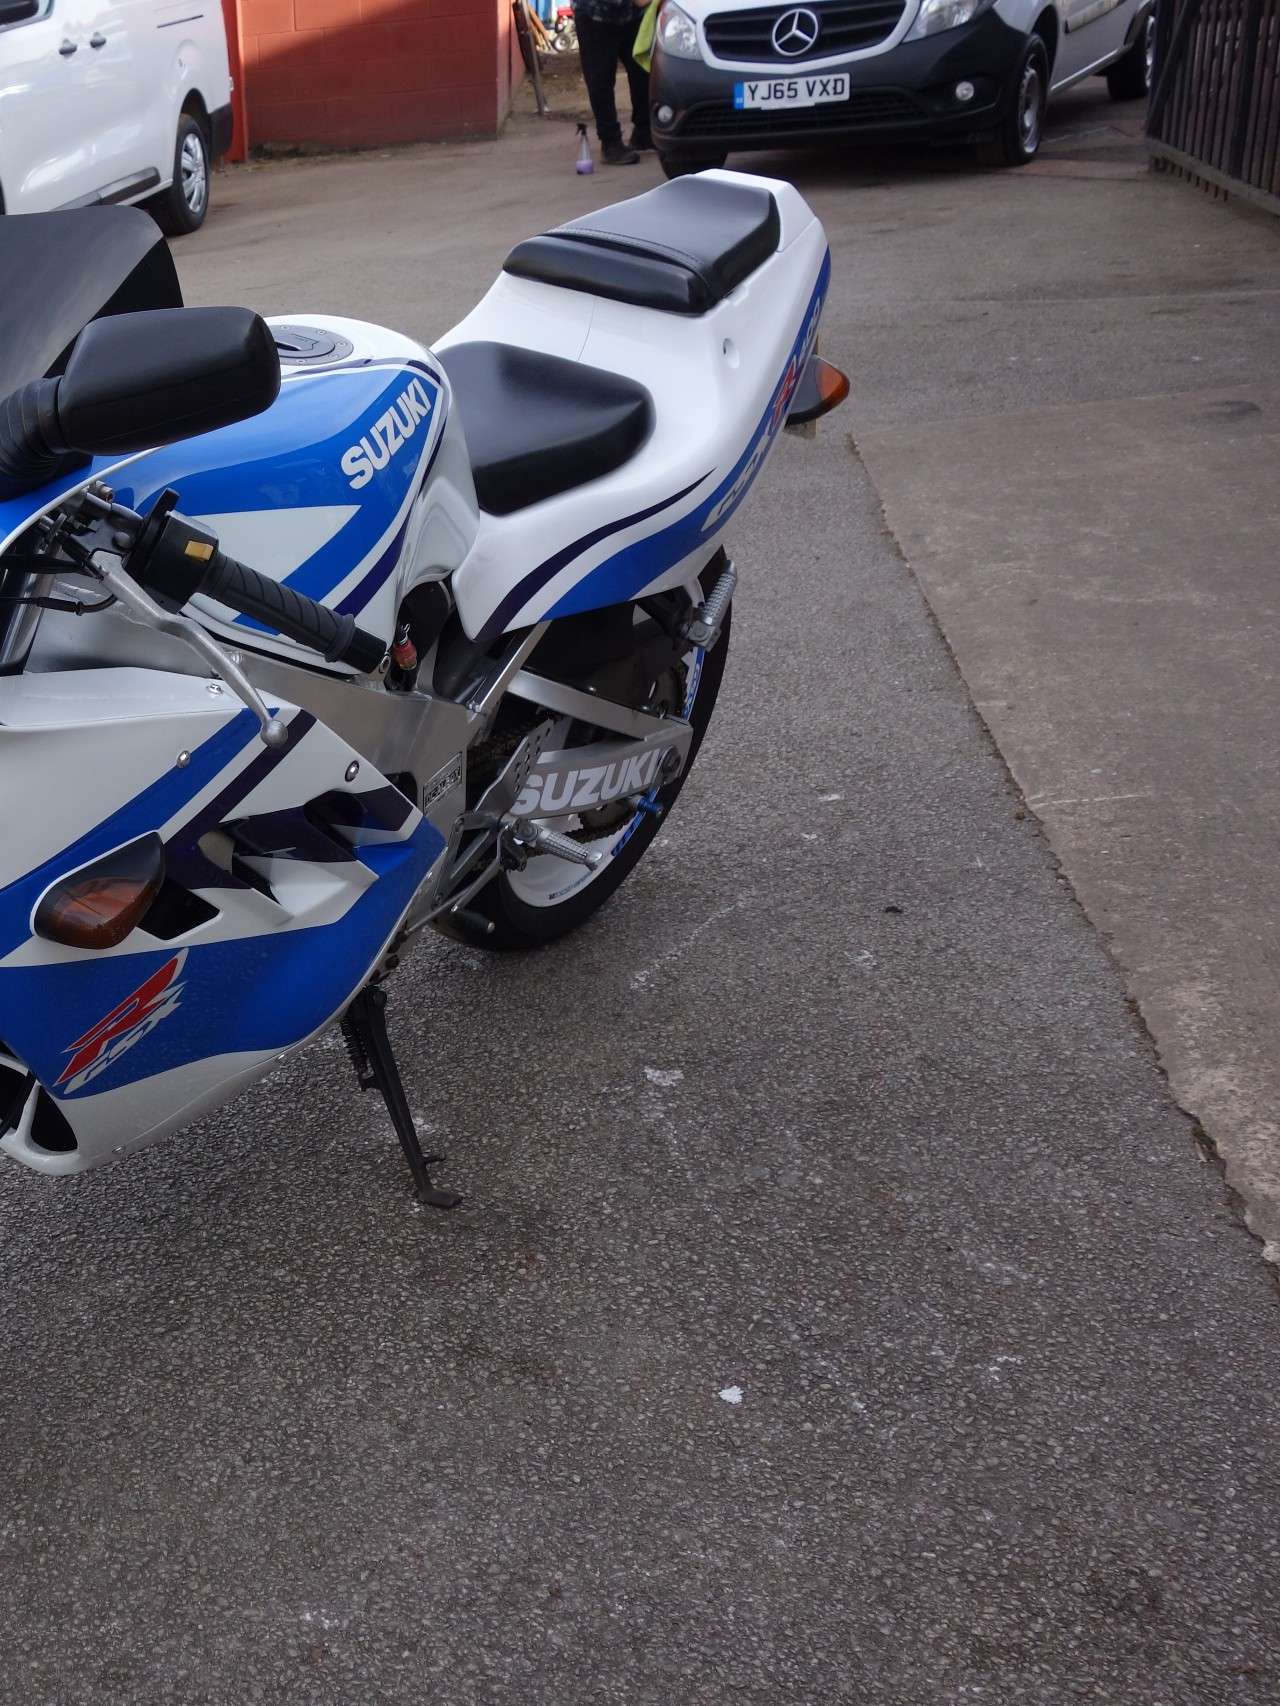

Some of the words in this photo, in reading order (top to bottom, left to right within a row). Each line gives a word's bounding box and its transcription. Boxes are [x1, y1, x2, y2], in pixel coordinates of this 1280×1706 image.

[748, 82, 798, 101] YJ65
[806, 78, 845, 97] VXD
[341, 377, 432, 490] SUZUKI
[510, 748, 661, 816] SUZUKI
